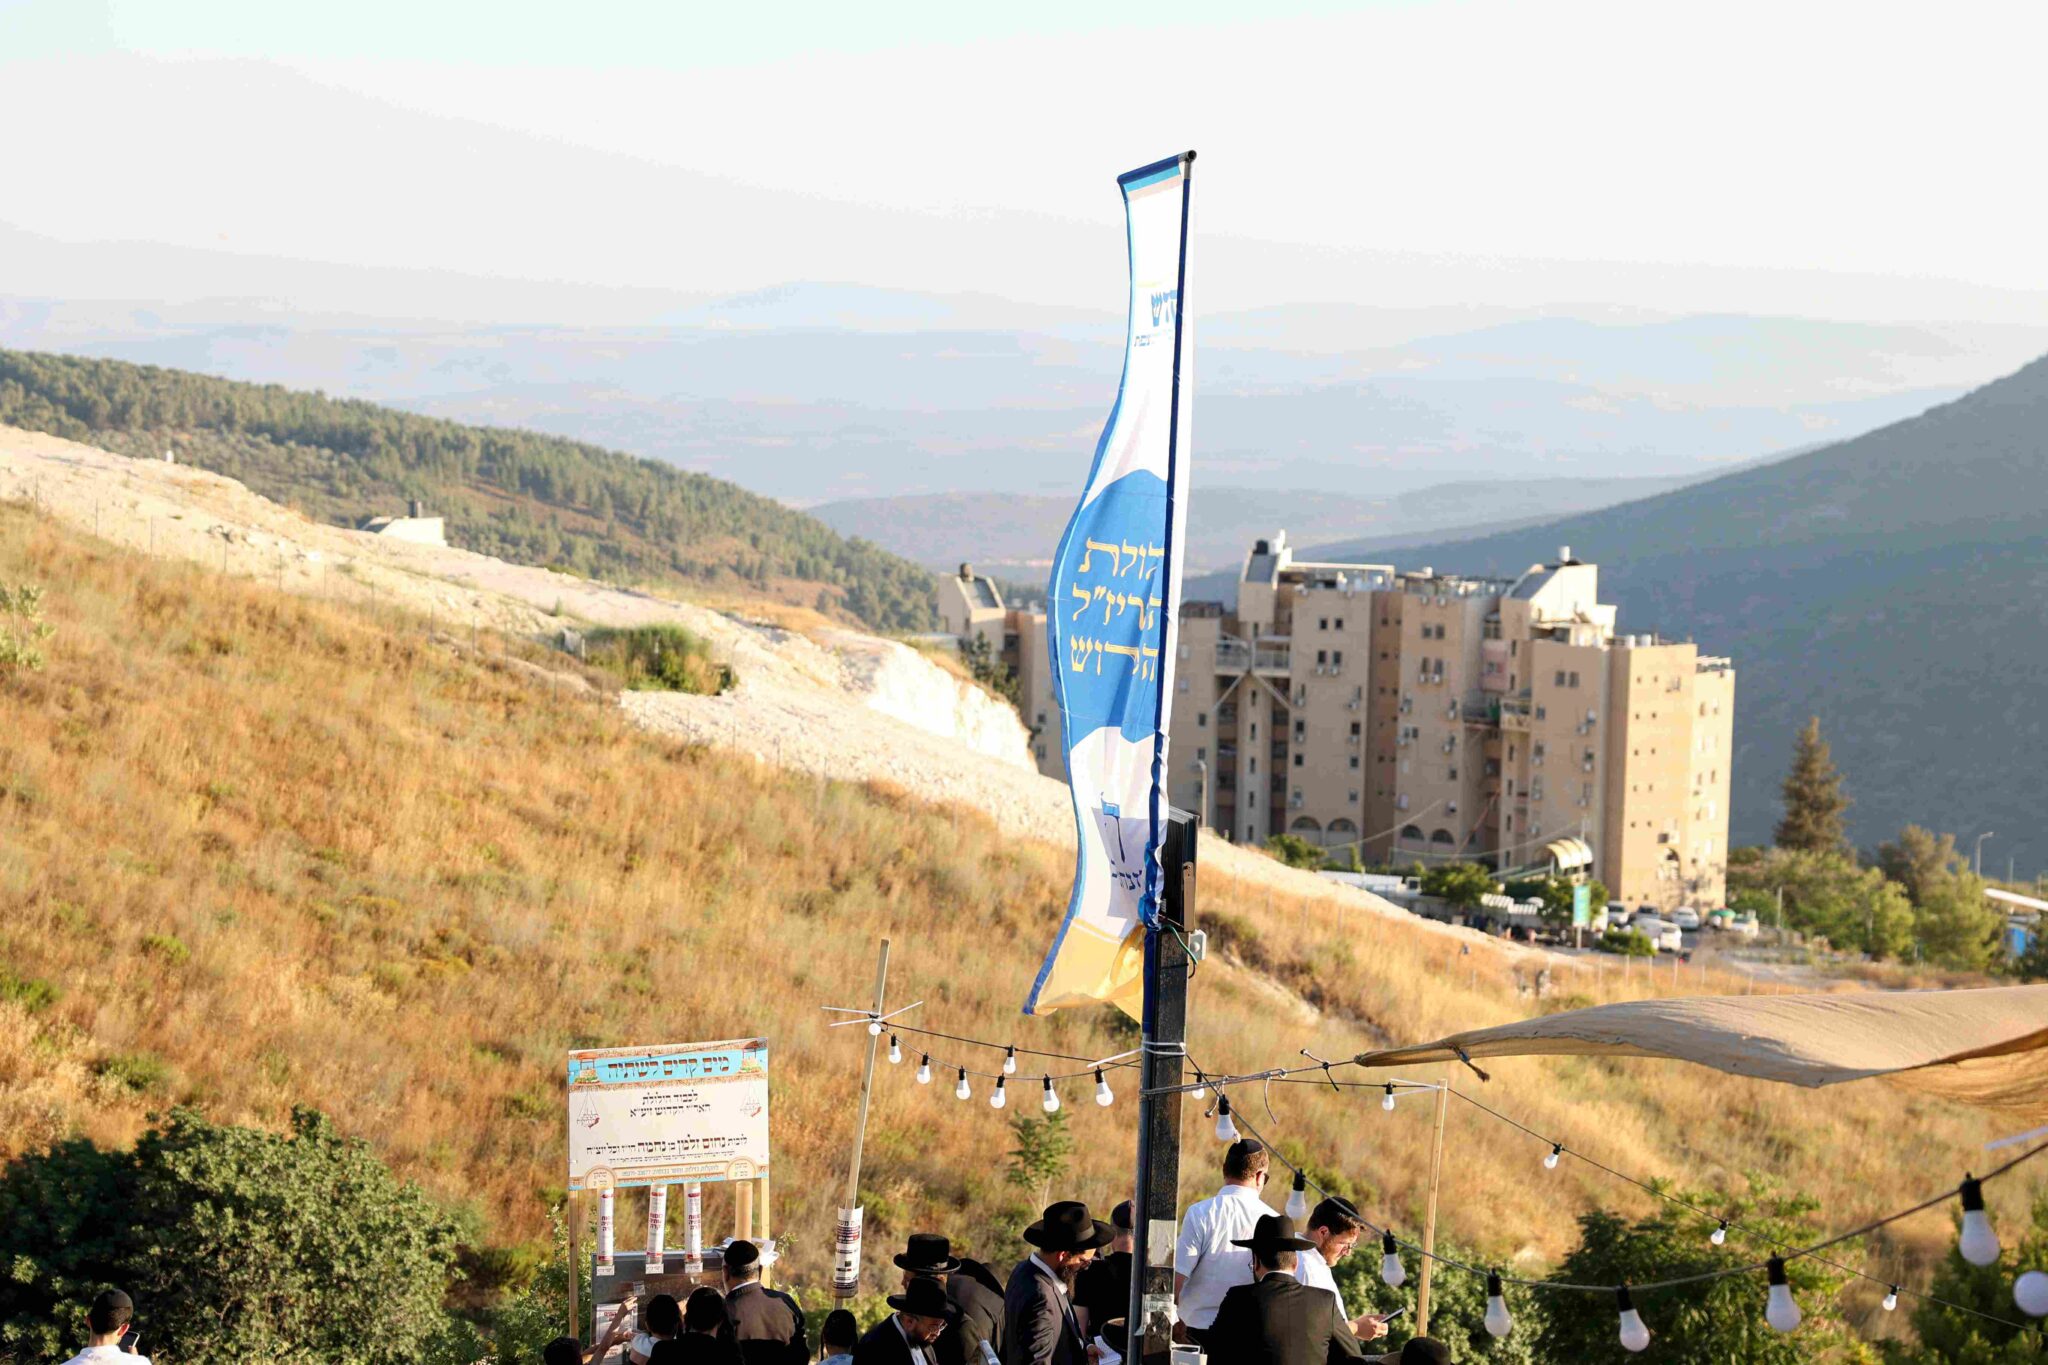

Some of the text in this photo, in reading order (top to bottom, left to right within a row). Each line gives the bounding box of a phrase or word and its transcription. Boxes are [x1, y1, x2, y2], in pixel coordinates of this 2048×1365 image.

[607, 1053, 729, 1079] מים קרים לשתיה
[642, 1089, 698, 1106] לכבוד הילולת
[654, 1105, 684, 1116] הקדוש
[637, 1140, 666, 1153] נחמה
[676, 1133, 700, 1155] זלמן
[702, 1136, 726, 1149] נחום
